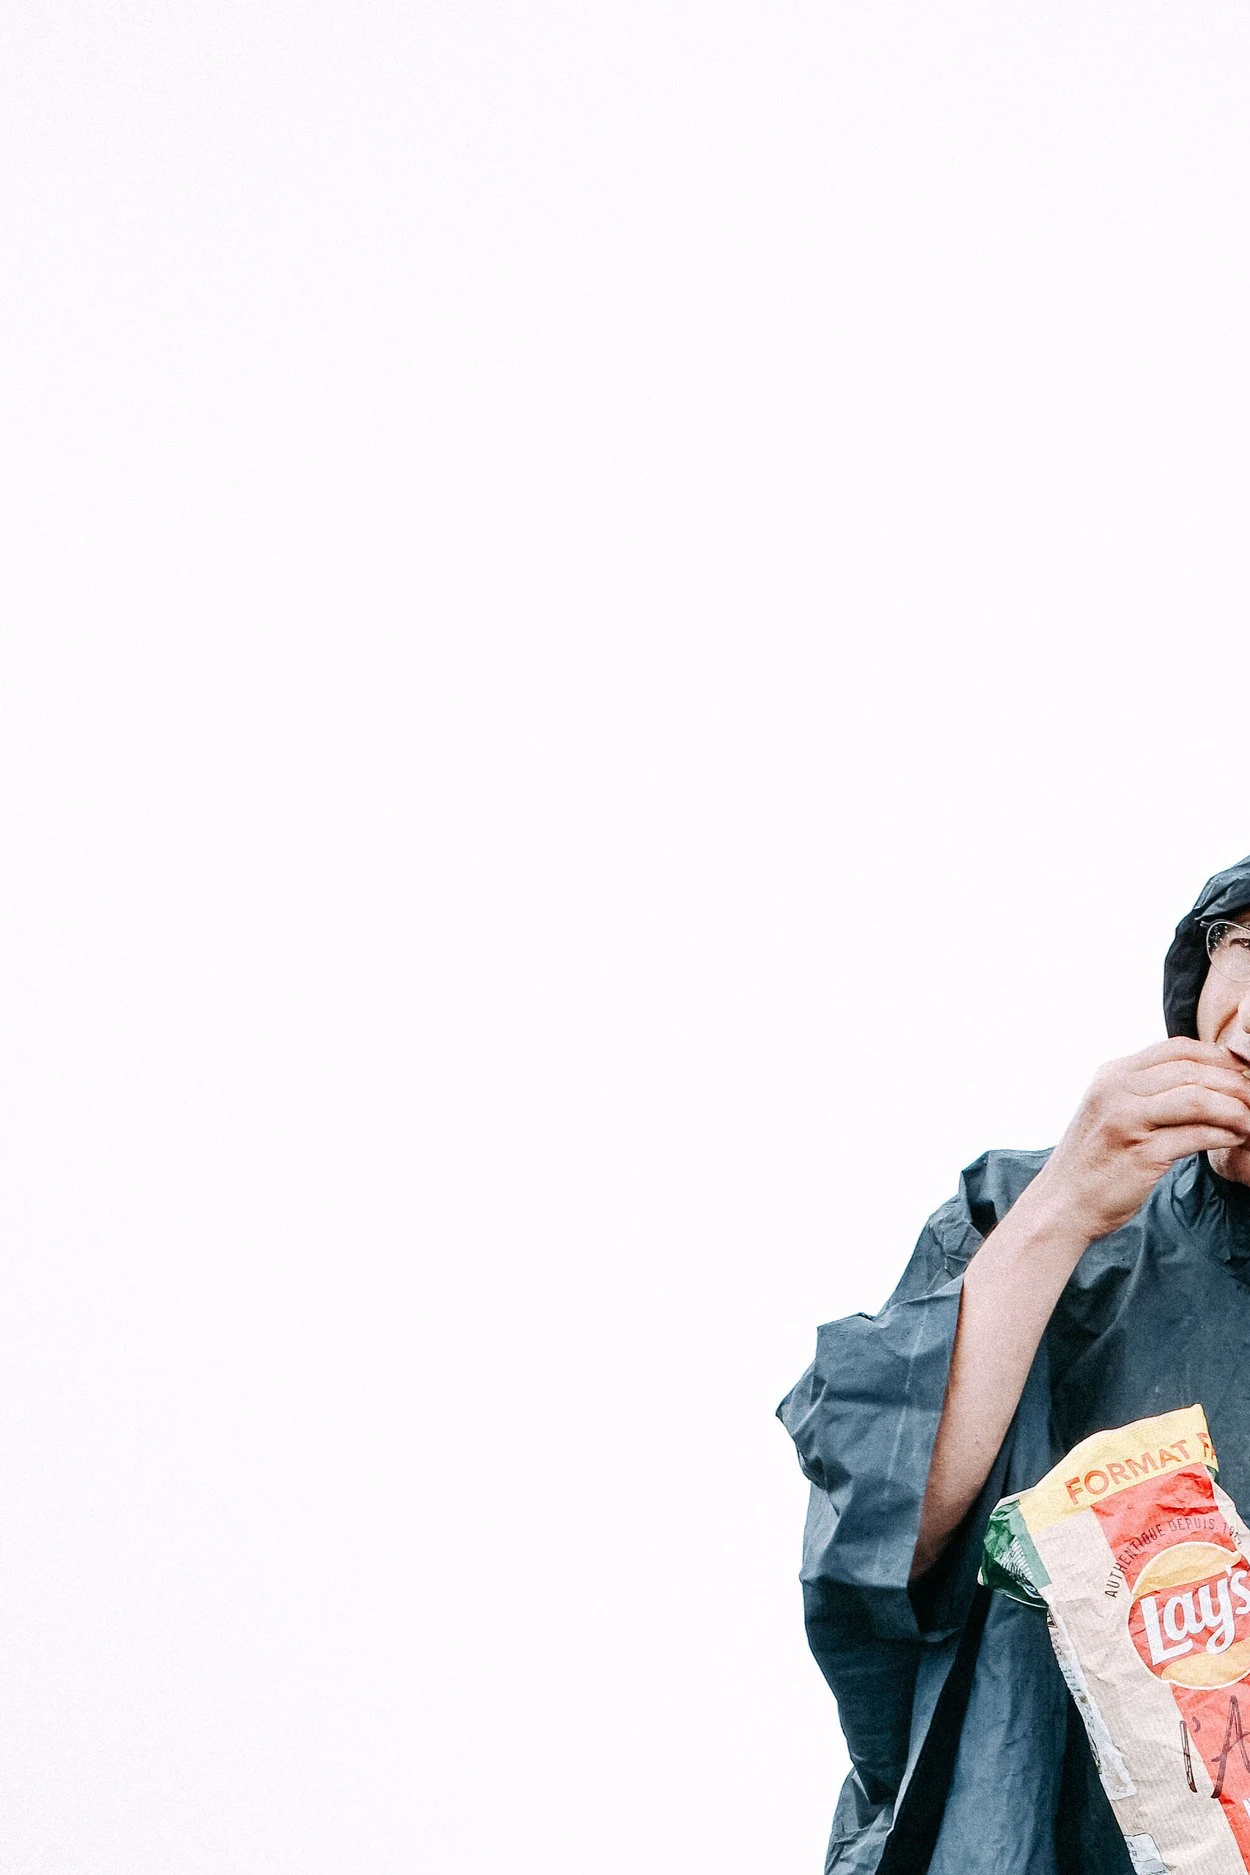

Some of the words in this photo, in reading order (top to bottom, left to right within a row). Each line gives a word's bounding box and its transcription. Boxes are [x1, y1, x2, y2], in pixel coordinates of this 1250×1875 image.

[1064, 1440, 1191, 1505] FORMAT
[1104, 1524, 1166, 1598] AUTHENTIQUE
[1168, 1518, 1216, 1533] DEPUIS
